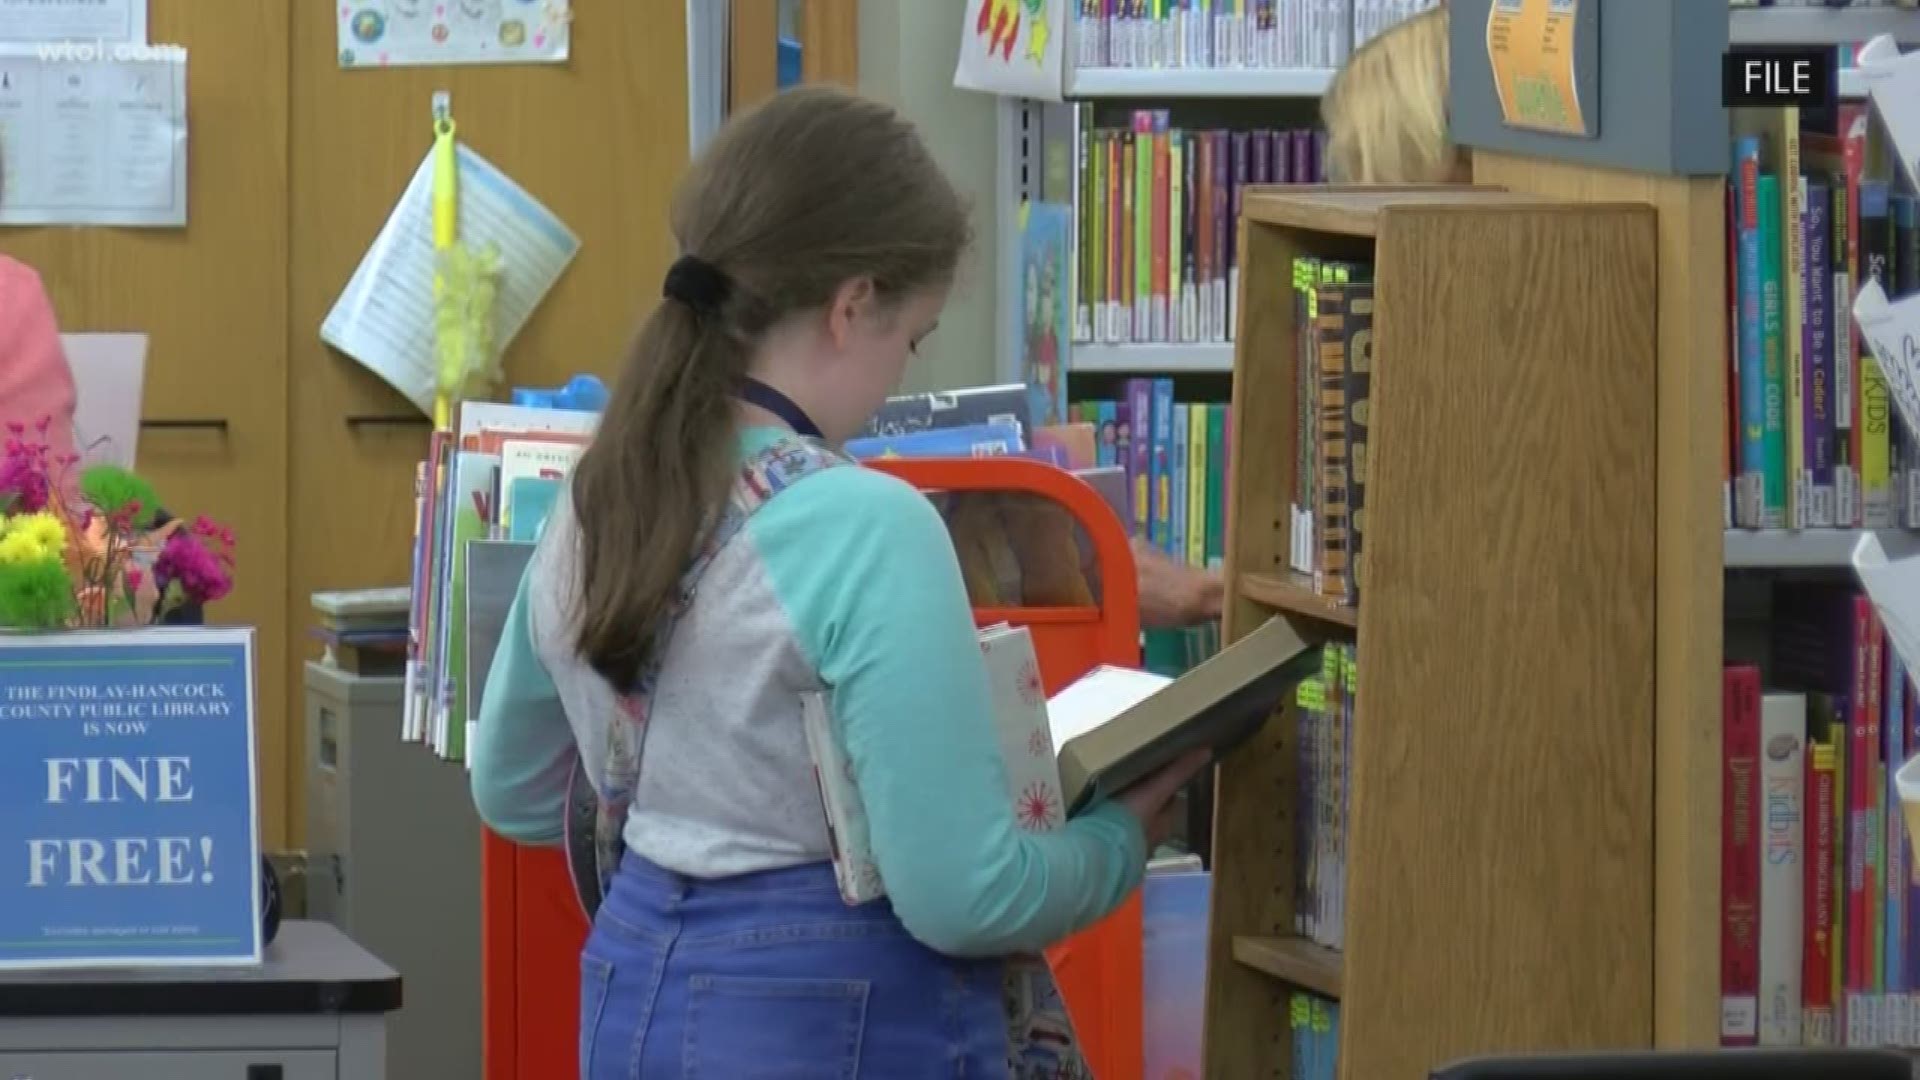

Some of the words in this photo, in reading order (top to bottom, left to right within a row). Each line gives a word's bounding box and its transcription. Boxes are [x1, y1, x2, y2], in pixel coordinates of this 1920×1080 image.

[1808, 206, 1823, 229] So,
[1811, 237, 1823, 262] You
[1812, 267, 1823, 302] Want
[1764, 280, 1779, 331] GIRLS
[1812, 310, 1824, 325] to
[1812, 330, 1824, 349] Be
[1813, 354, 1822, 364] a
[1812, 368, 1825, 419] Coder?
[1864, 376, 1888, 434] KIDS
[1766, 383, 1780, 432] CODE
[4, 686, 44, 701] THE
[48, 683, 225, 699] FINDLAY-HANCOCK
[0, 704, 75, 719] COUNTY
[79, 702, 148, 718] PUBLIC
[151, 701, 231, 716] LIBRARY
[83, 722, 99, 736] IS
[104, 721, 149, 736] NOW
[44, 755, 194, 804] FINE
[25, 835, 215, 888] FREE!
